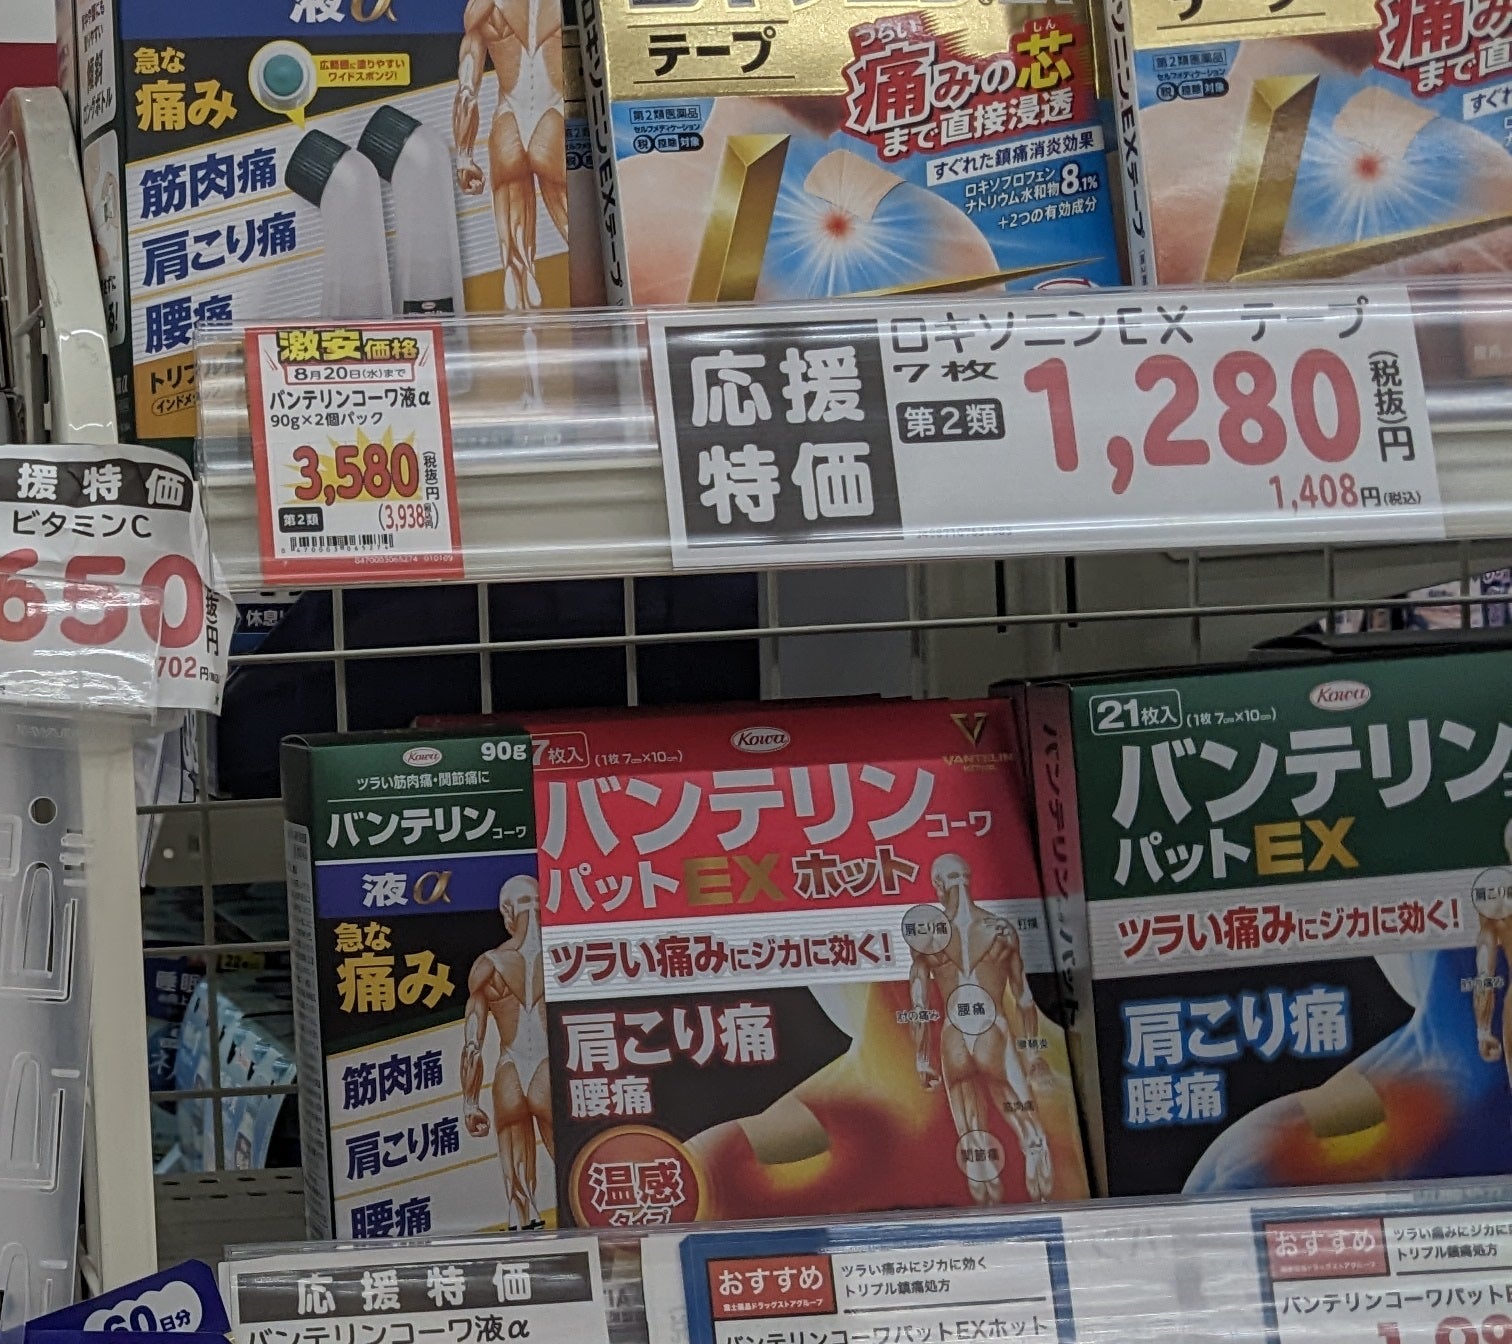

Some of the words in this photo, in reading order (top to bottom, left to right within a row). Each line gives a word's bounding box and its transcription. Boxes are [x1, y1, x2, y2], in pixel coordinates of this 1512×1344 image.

[134, 47, 186, 74] 急な
[649, 26, 776, 77] テープ
[135, 79, 238, 132] 痛み
[884, 90, 1074, 157] まで直接浸透
[139, 147, 277, 220] 筋肉痛
[142, 210, 297, 287] 肩こり痛
[270, 387, 430, 410] バンテリンコーワ液α
[690, 346, 866, 428] 応援
[906, 406, 998, 437] 第2類
[1025, 348, 1361, 494] 1,280
[293, 443, 419, 506] 3,580
[698, 440, 875, 523] 特価
[12, 510, 152, 538] ビタミンC
[284, 514, 319, 527] 第2類
[481, 742, 527, 760] 90g
[327, 807, 494, 849] バンテリン
[542, 764, 935, 859] バンテリン
[335, 922, 391, 952] 急な
[905, 921, 948, 936] 肩こり痛
[337, 950, 455, 1013] 痛み
[957, 1003, 985, 1017] 腰痛
[1125, 988, 1348, 1068] 肩こり痛
[563, 1004, 776, 1071] 肩こり痛
[341, 1050, 443, 1110] 筋肉痛
[570, 1076, 652, 1118] 腰痛
[1126, 1073, 1222, 1123] 腰痛
[346, 1117, 459, 1180] 肩こり痛
[590, 1159, 684, 1208] 温感
[352, 1196, 432, 1238] 腰痛
[298, 1262, 531, 1314] 応援特価
[718, 1266, 823, 1296] おすすめ
[841, 1256, 986, 1278] ツラい痛みにジカに効く
